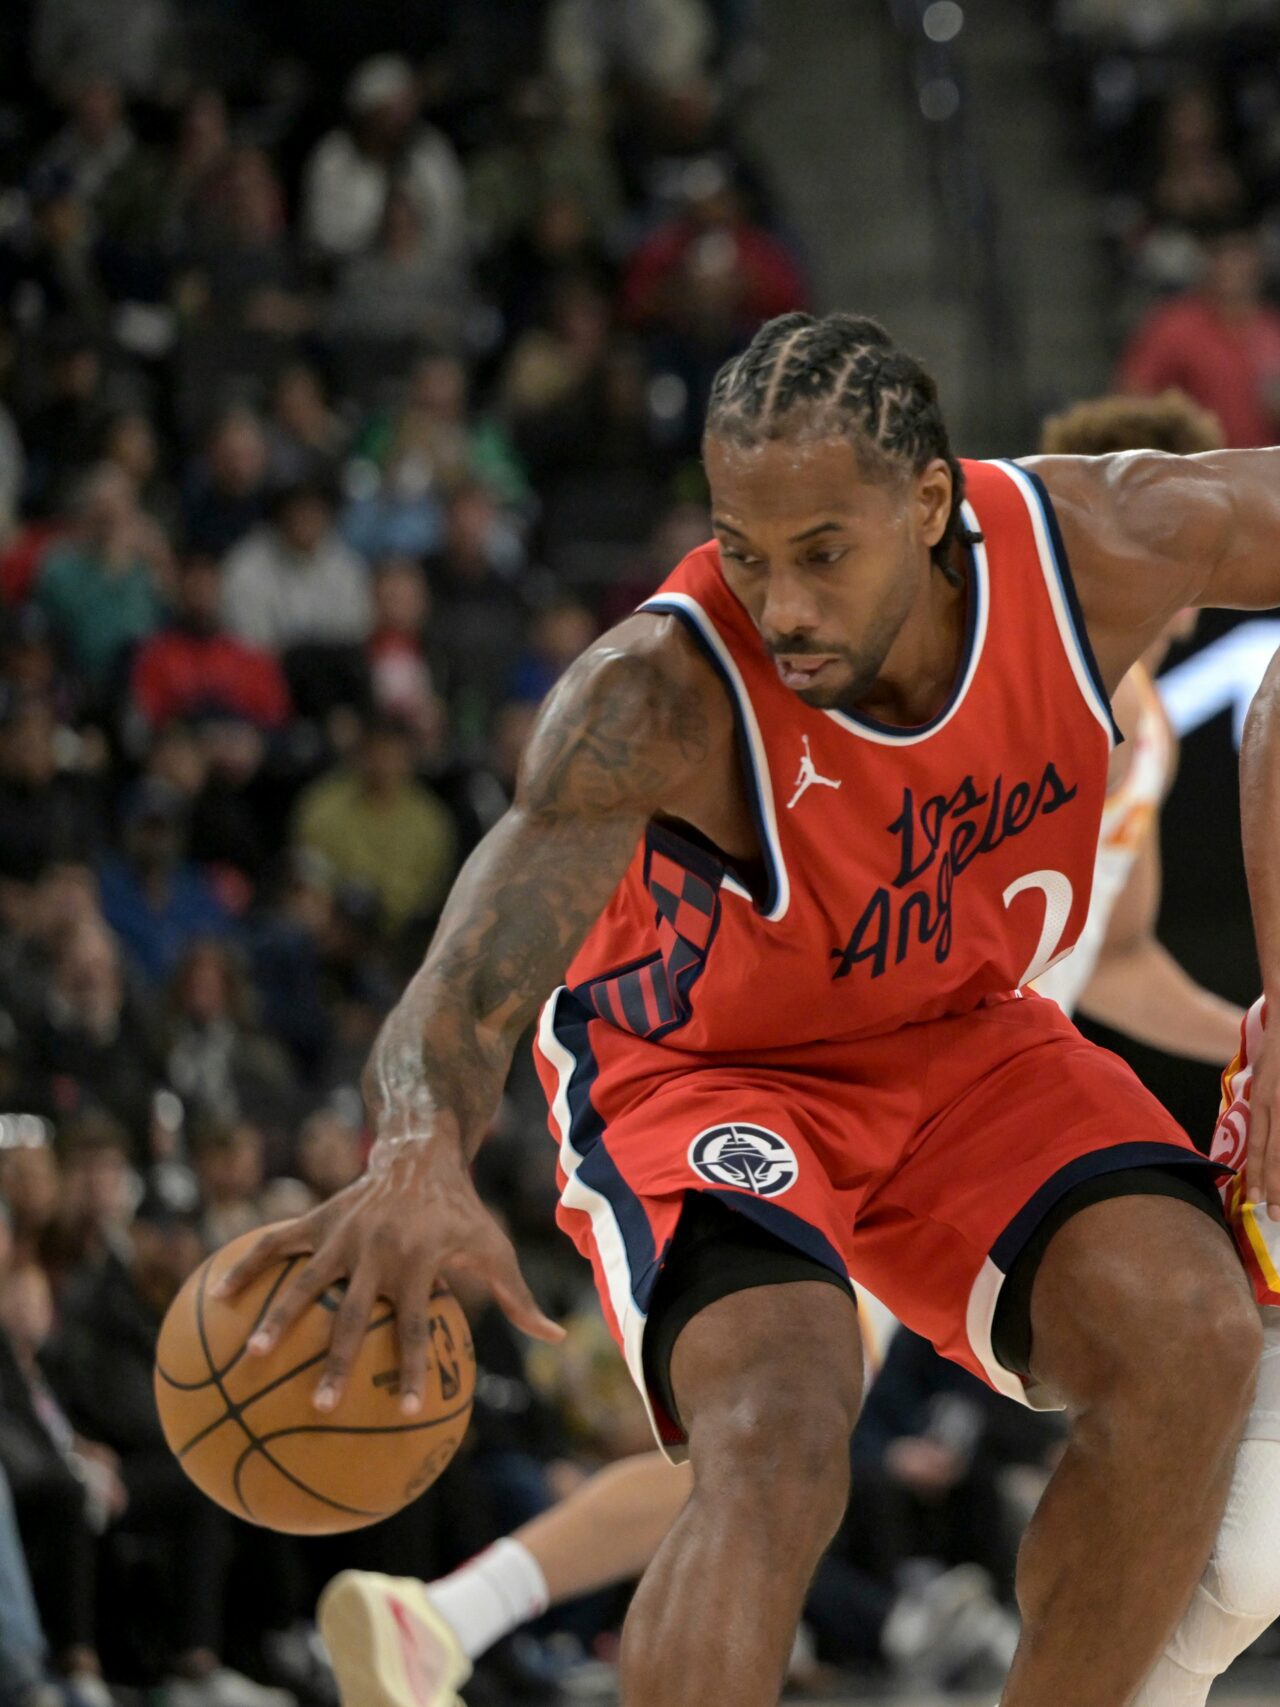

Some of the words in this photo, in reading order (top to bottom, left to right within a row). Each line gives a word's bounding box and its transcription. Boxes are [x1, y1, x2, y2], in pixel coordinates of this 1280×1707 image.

[830, 761, 1078, 981] Angeles
[886, 774, 989, 889] Los
[1002, 869, 1076, 991] 2
